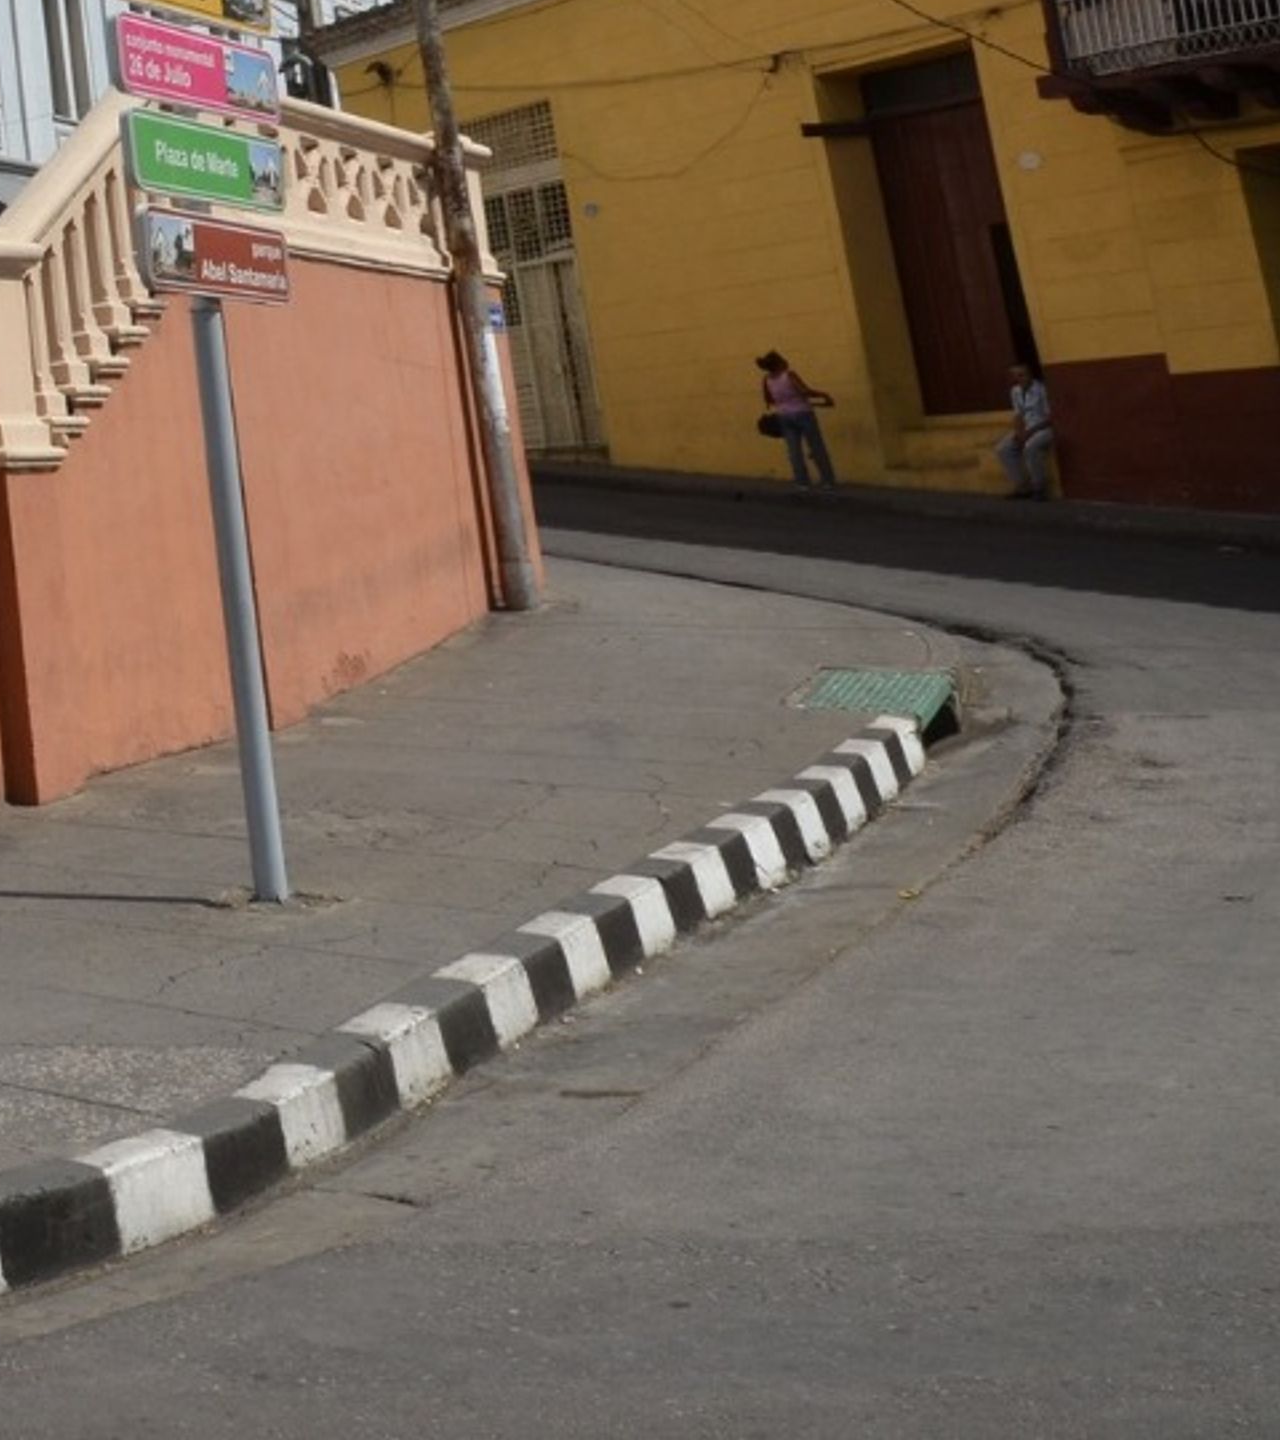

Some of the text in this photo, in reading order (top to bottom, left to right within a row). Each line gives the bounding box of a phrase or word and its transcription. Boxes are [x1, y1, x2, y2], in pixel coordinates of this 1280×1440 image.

[145, 59, 161, 82] de
[155, 140, 188, 169] Plaza
[190, 149, 205, 173] de
[201, 258, 226, 283] Abel
